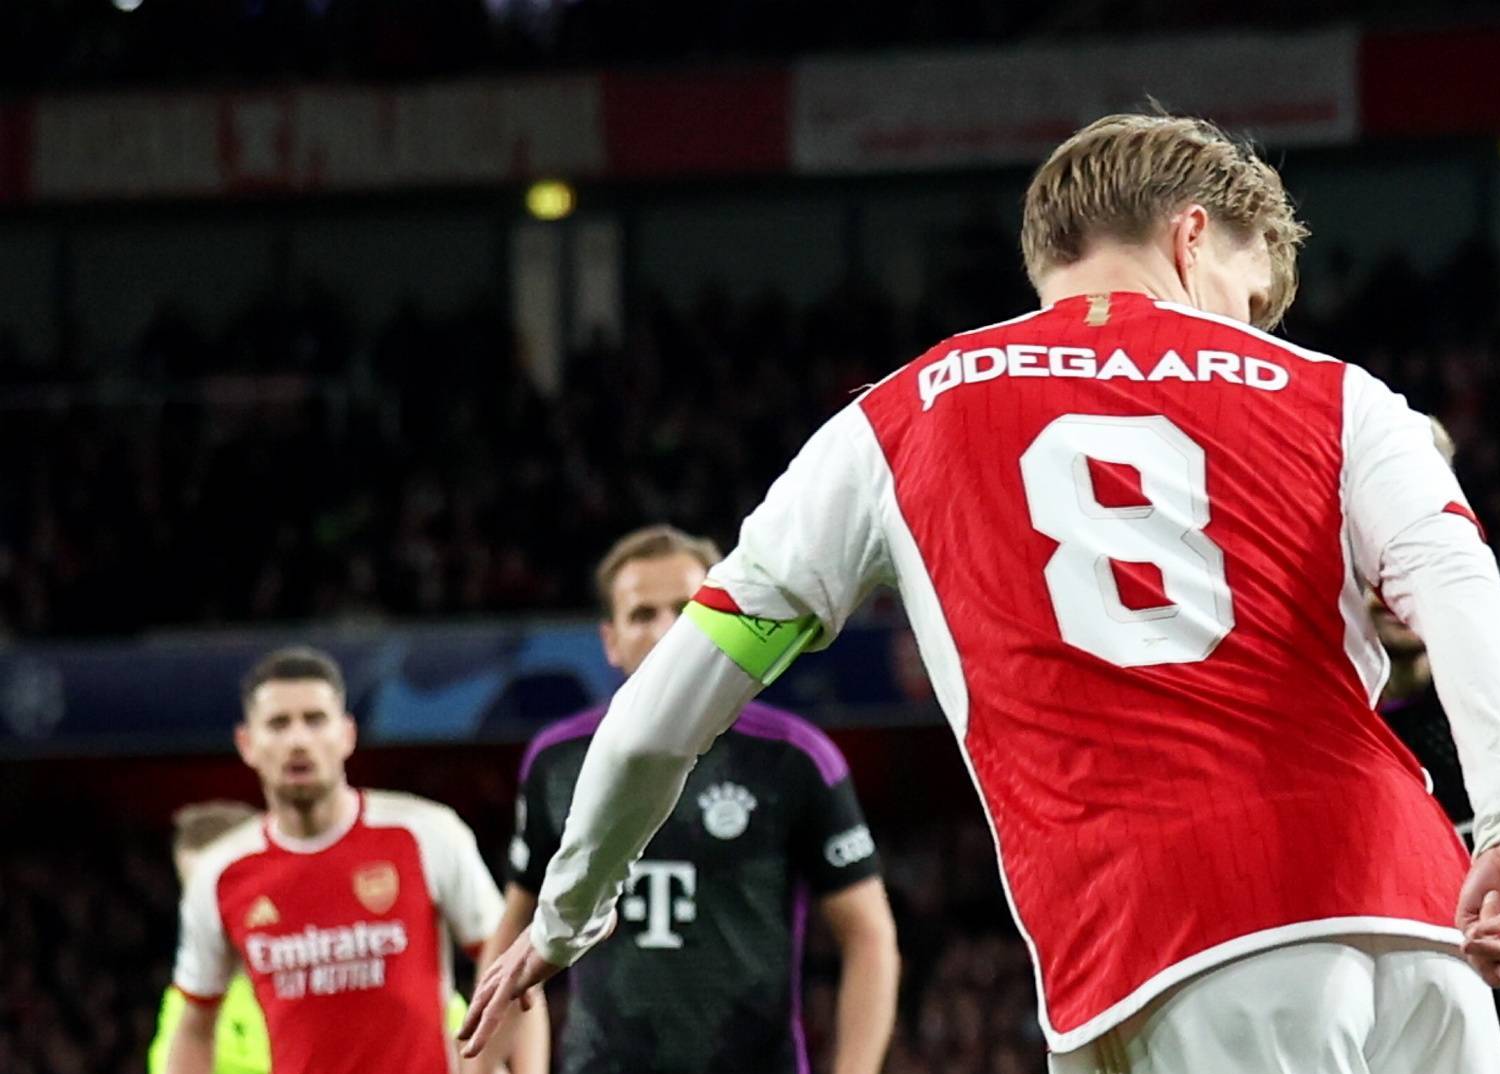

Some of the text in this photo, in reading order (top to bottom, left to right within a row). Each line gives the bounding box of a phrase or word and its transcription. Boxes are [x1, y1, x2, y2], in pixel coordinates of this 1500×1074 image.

[918, 344, 1290, 411] ØDEGAARD
[1019, 413, 1236, 668] 8
[624, 861, 697, 948] T
[246, 920, 408, 973] Emirates
